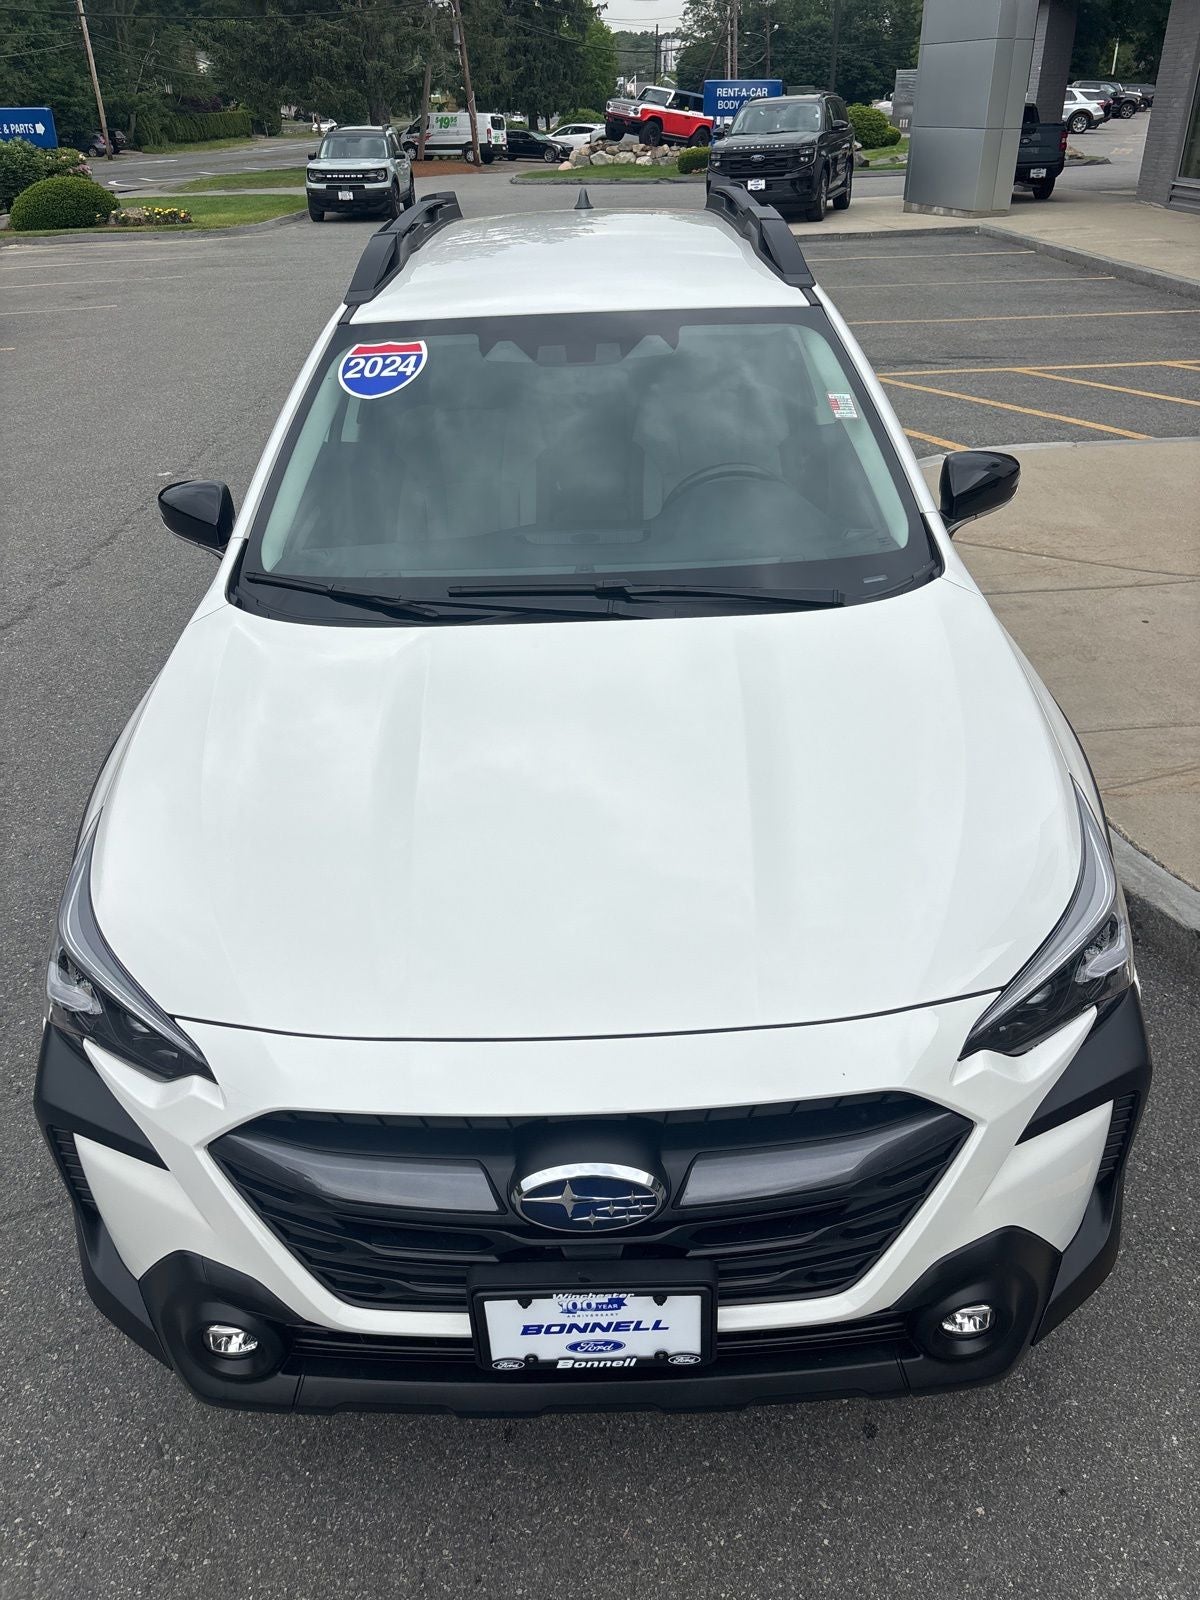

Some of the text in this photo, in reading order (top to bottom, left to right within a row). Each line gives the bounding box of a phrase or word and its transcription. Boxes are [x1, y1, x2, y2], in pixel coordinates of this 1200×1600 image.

[716, 87, 768, 96] RENT-A-CAR
[717, 100, 739, 109] BODY
[3, 124, 9, 134] &
[10, 124, 34, 134] PARTS
[344, 355, 417, 379] 2024
[560, 1299, 597, 1313] 100
[520, 1320, 670, 1336] BONNELL
[577, 1340, 613, 1352] Ford
[496, 1361, 521, 1369] Ford
[556, 1358, 637, 1369] Bonnell
[673, 1356, 697, 1364] Ford
